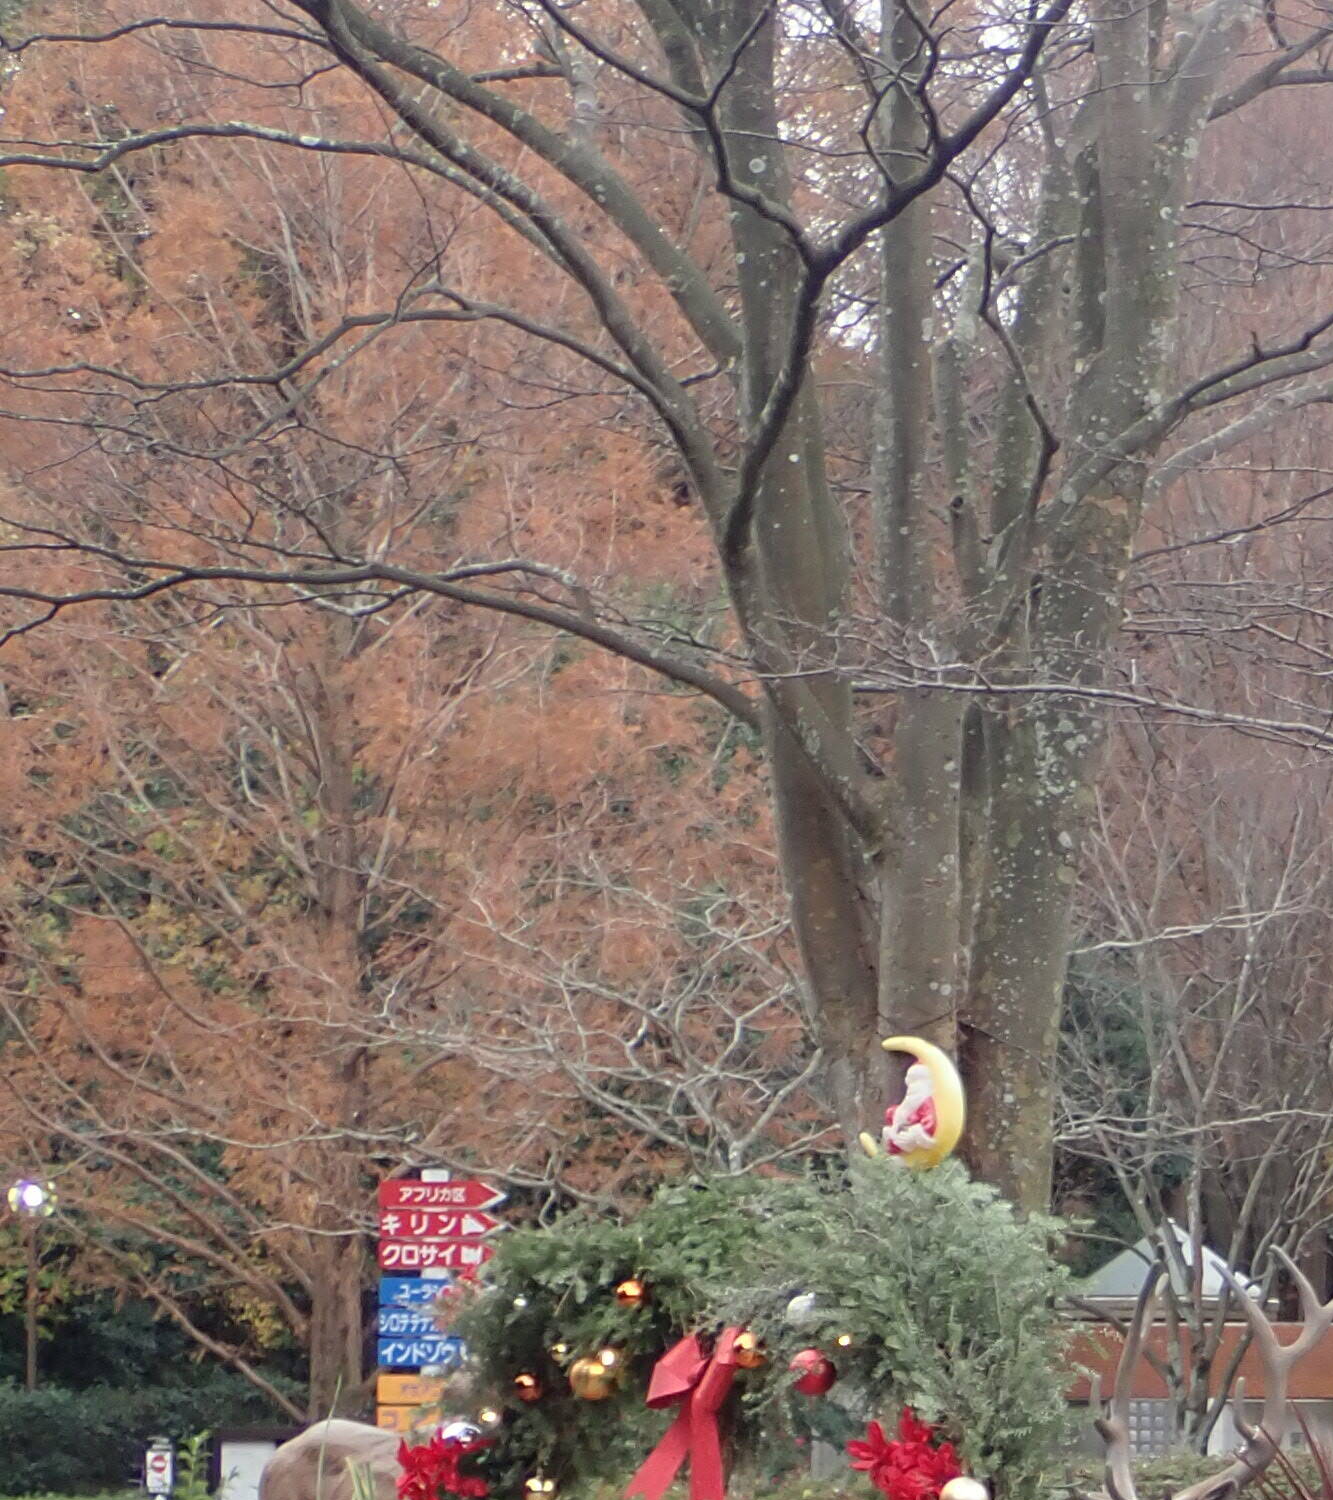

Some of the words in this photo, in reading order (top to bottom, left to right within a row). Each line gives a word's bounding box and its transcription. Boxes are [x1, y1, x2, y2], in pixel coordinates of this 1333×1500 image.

[399, 1187, 466, 1203] アフリカ区
[381, 1213, 458, 1235] キリン
[381, 1244, 457, 1265] クロサイ
[400, 1283, 438, 1299] ユーラ
[381, 1342, 457, 1363] インドゾウ
